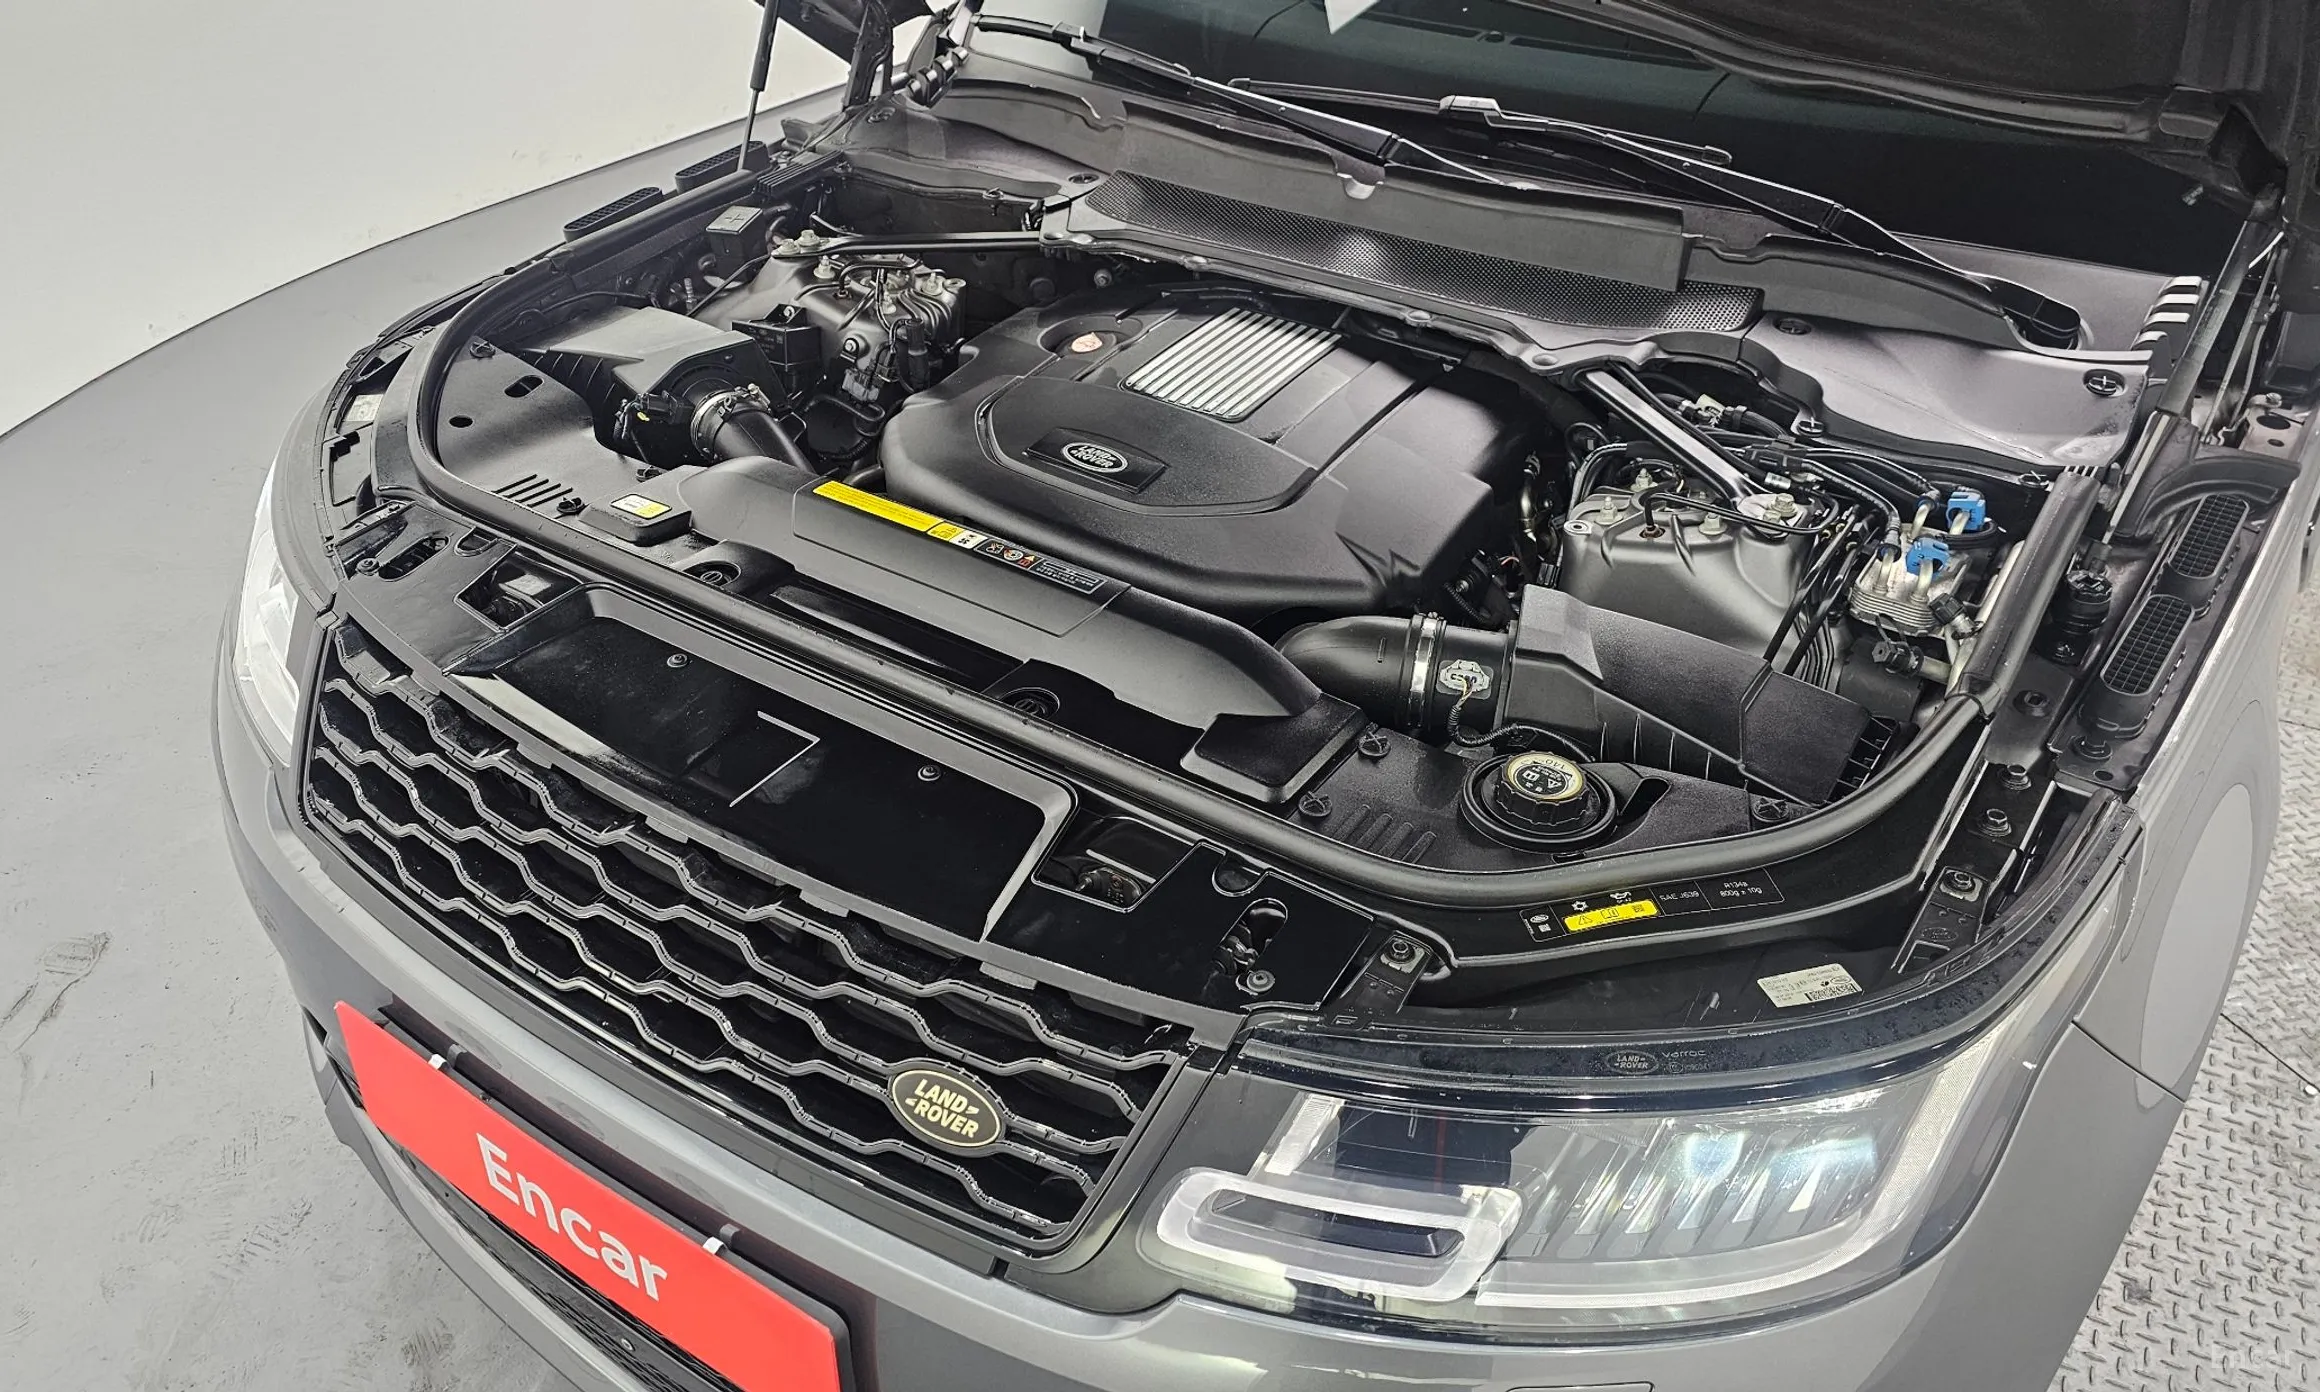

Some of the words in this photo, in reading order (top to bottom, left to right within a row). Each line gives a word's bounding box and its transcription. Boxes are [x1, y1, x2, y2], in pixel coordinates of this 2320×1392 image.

[1074, 451, 1114, 468] ROVER
[1077, 445, 1111, 460] LAND
[1616, 1053, 1640, 1062] LAND
[1619, 1061, 1649, 1070] ROVER
[914, 1078, 968, 1114] LAND
[913, 1098, 980, 1138] ROVER
[475, 1132, 668, 1302] Encar
